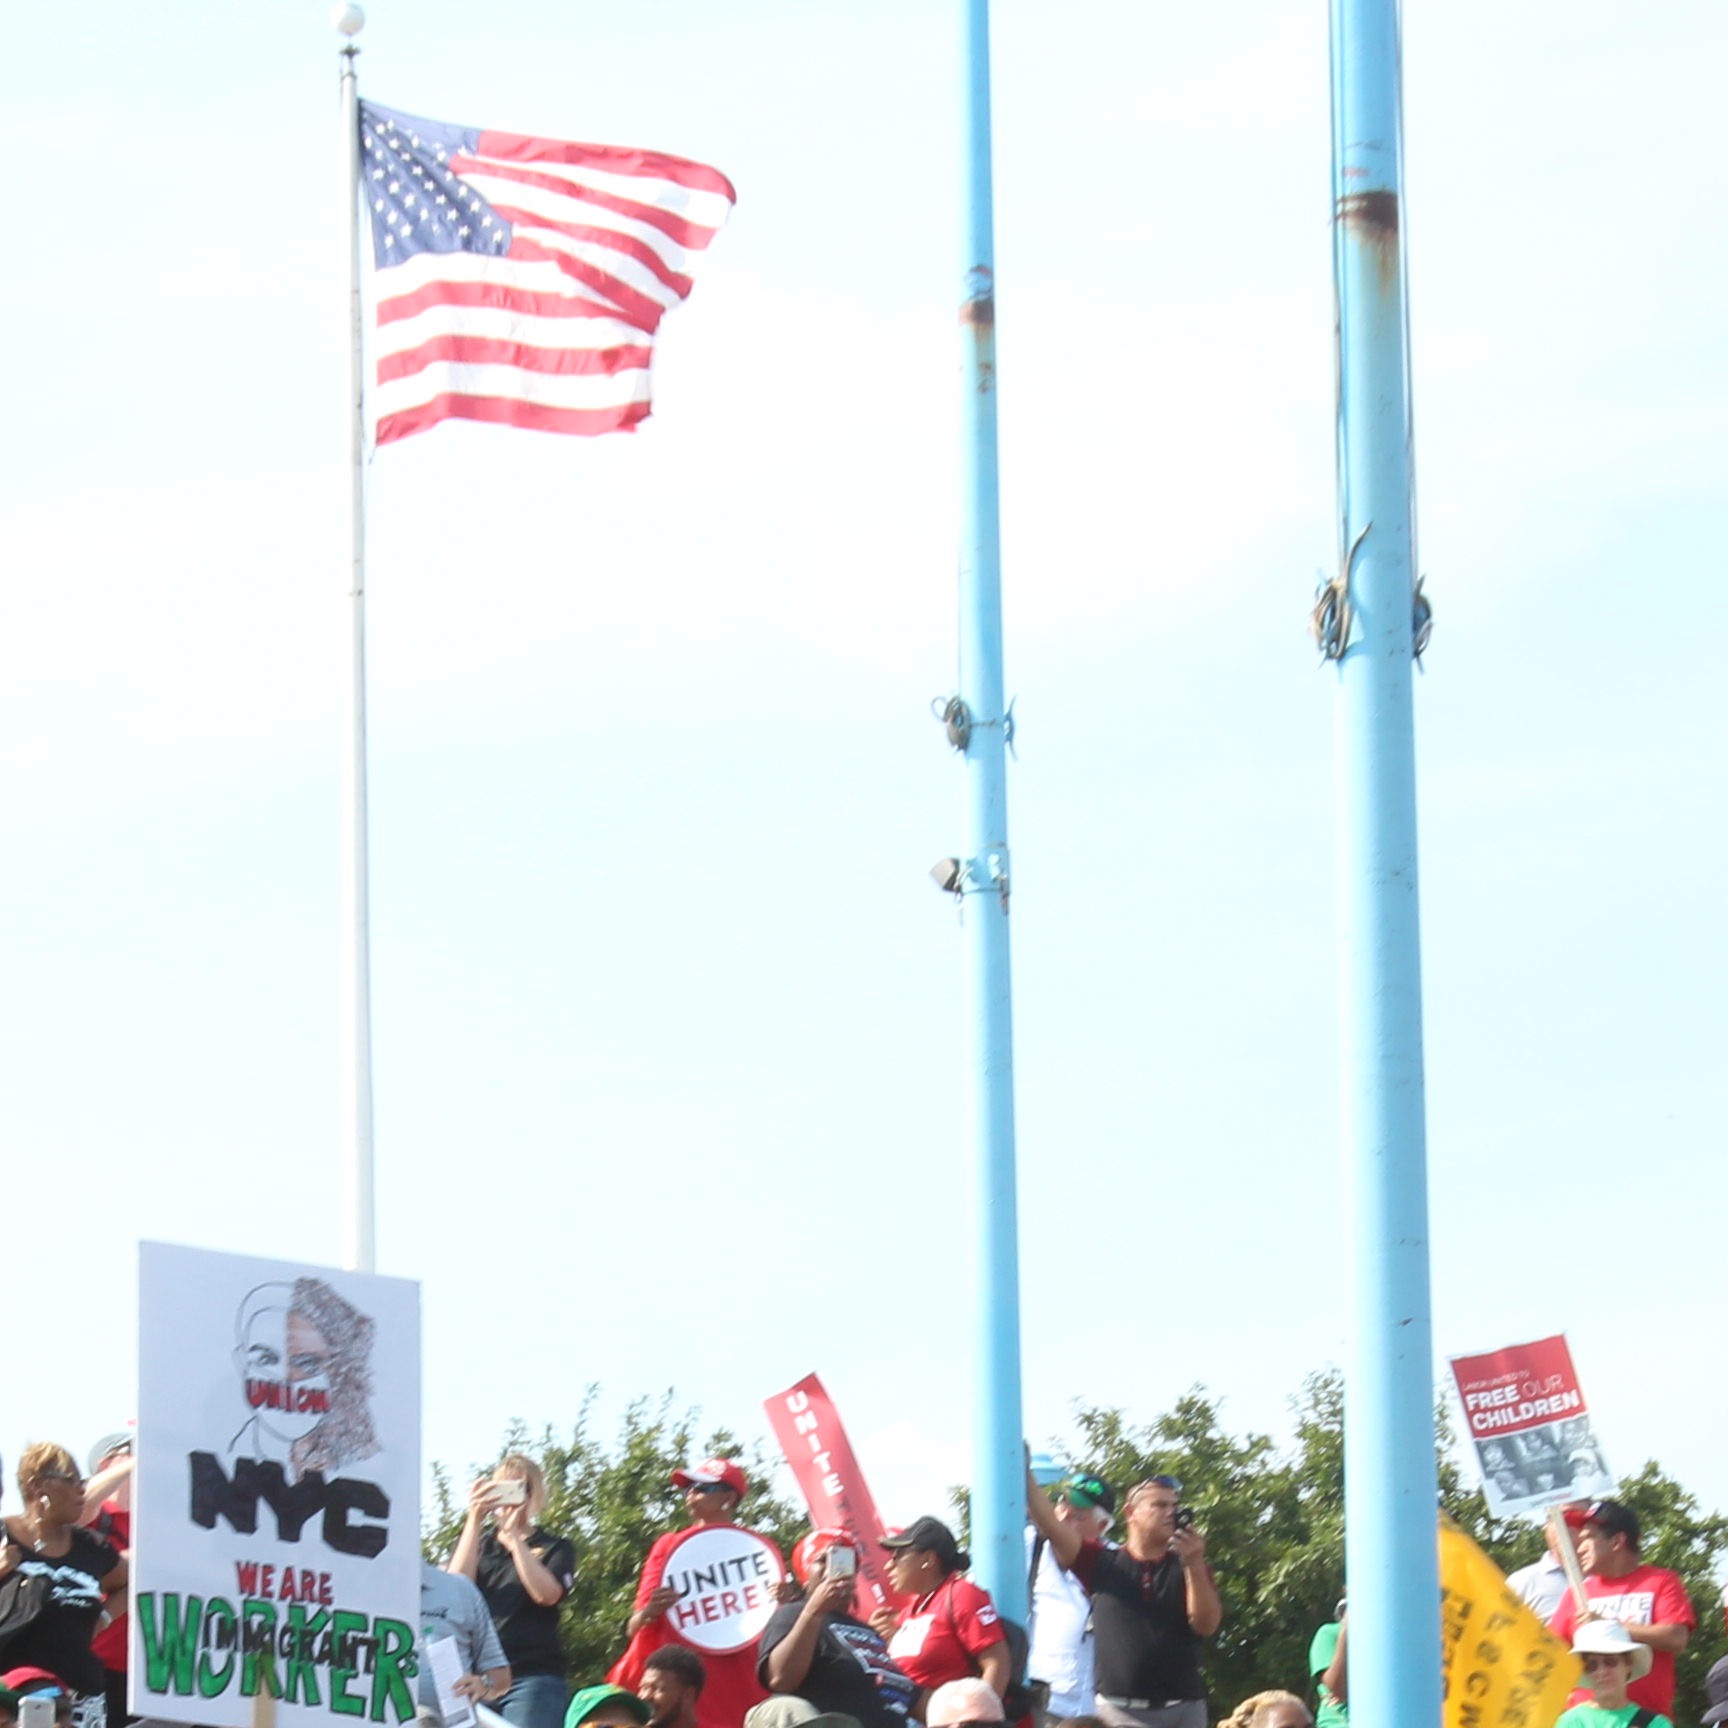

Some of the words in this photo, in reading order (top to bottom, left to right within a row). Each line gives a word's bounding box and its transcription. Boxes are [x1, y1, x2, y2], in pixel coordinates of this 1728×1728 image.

[1465, 1384, 1521, 1411] FREE
[1522, 1373, 1565, 1398] OUR
[1472, 1389, 1581, 1431] CHILDREN
[785, 1390, 845, 1498] UNITE
[189, 1450, 391, 1559] NYC
[235, 1561, 276, 1597] WE
[279, 1566, 334, 1605] ARE
[667, 1550, 770, 1598] UNITE
